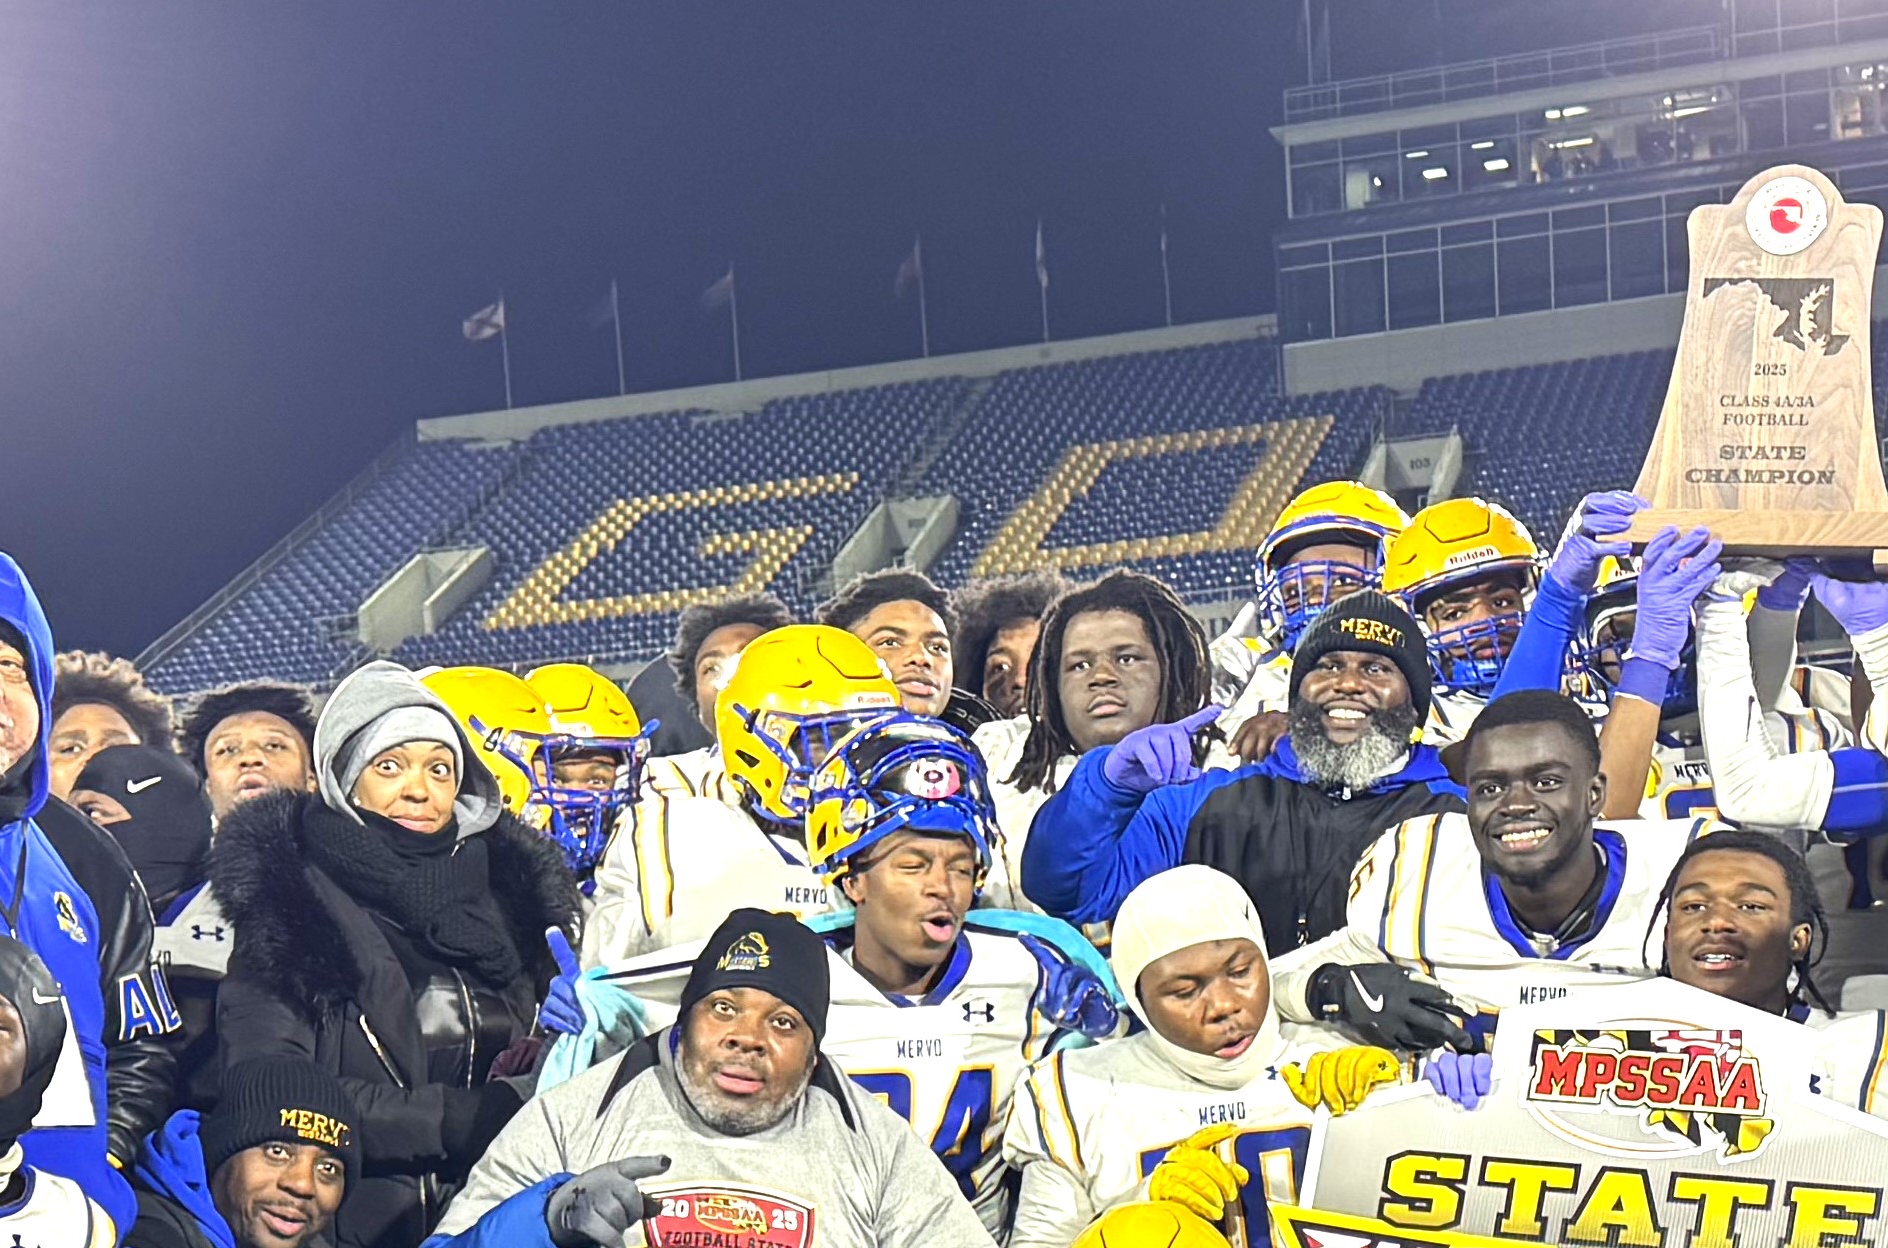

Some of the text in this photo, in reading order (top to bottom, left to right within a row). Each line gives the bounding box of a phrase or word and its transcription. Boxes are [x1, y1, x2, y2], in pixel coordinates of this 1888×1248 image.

[1754, 363, 1787, 376] 2025
[1720, 394, 1815, 408] CLASS 4A/3A
[1723, 413, 1809, 426] FOOTBALL
[1719, 445, 1806, 460] STATE
[1410, 457, 1431, 470] 103
[1685, 468, 1835, 485] CHAMPION
[785, 886, 828, 905] MERVO
[897, 1038, 942, 1058] MERVO
[1533, 1048, 1762, 1110] MPSSAA
[1198, 1101, 1246, 1126] MERVO
[661, 1199, 690, 1218] 20
[771, 1208, 799, 1231] 25
